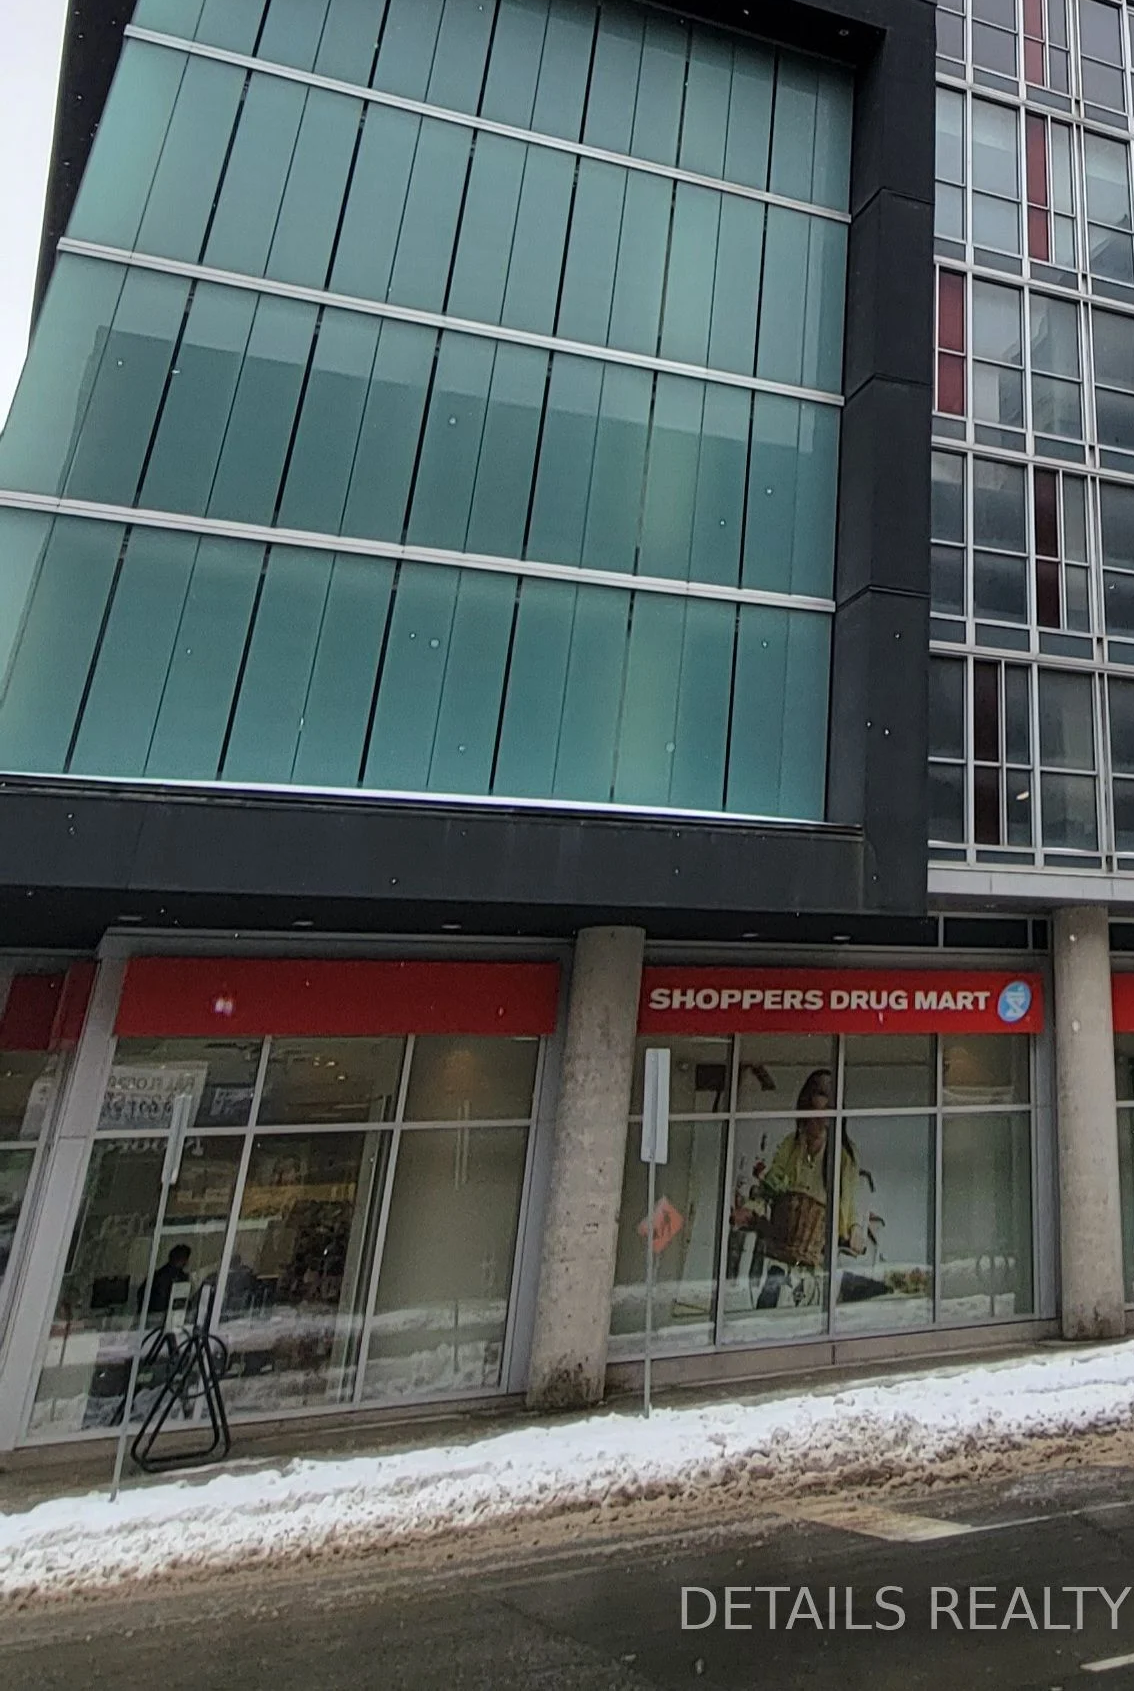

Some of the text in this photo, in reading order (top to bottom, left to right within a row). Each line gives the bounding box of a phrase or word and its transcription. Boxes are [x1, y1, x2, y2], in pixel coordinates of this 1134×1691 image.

[649, 988, 991, 1011] SHOPPERS DRUG MART
